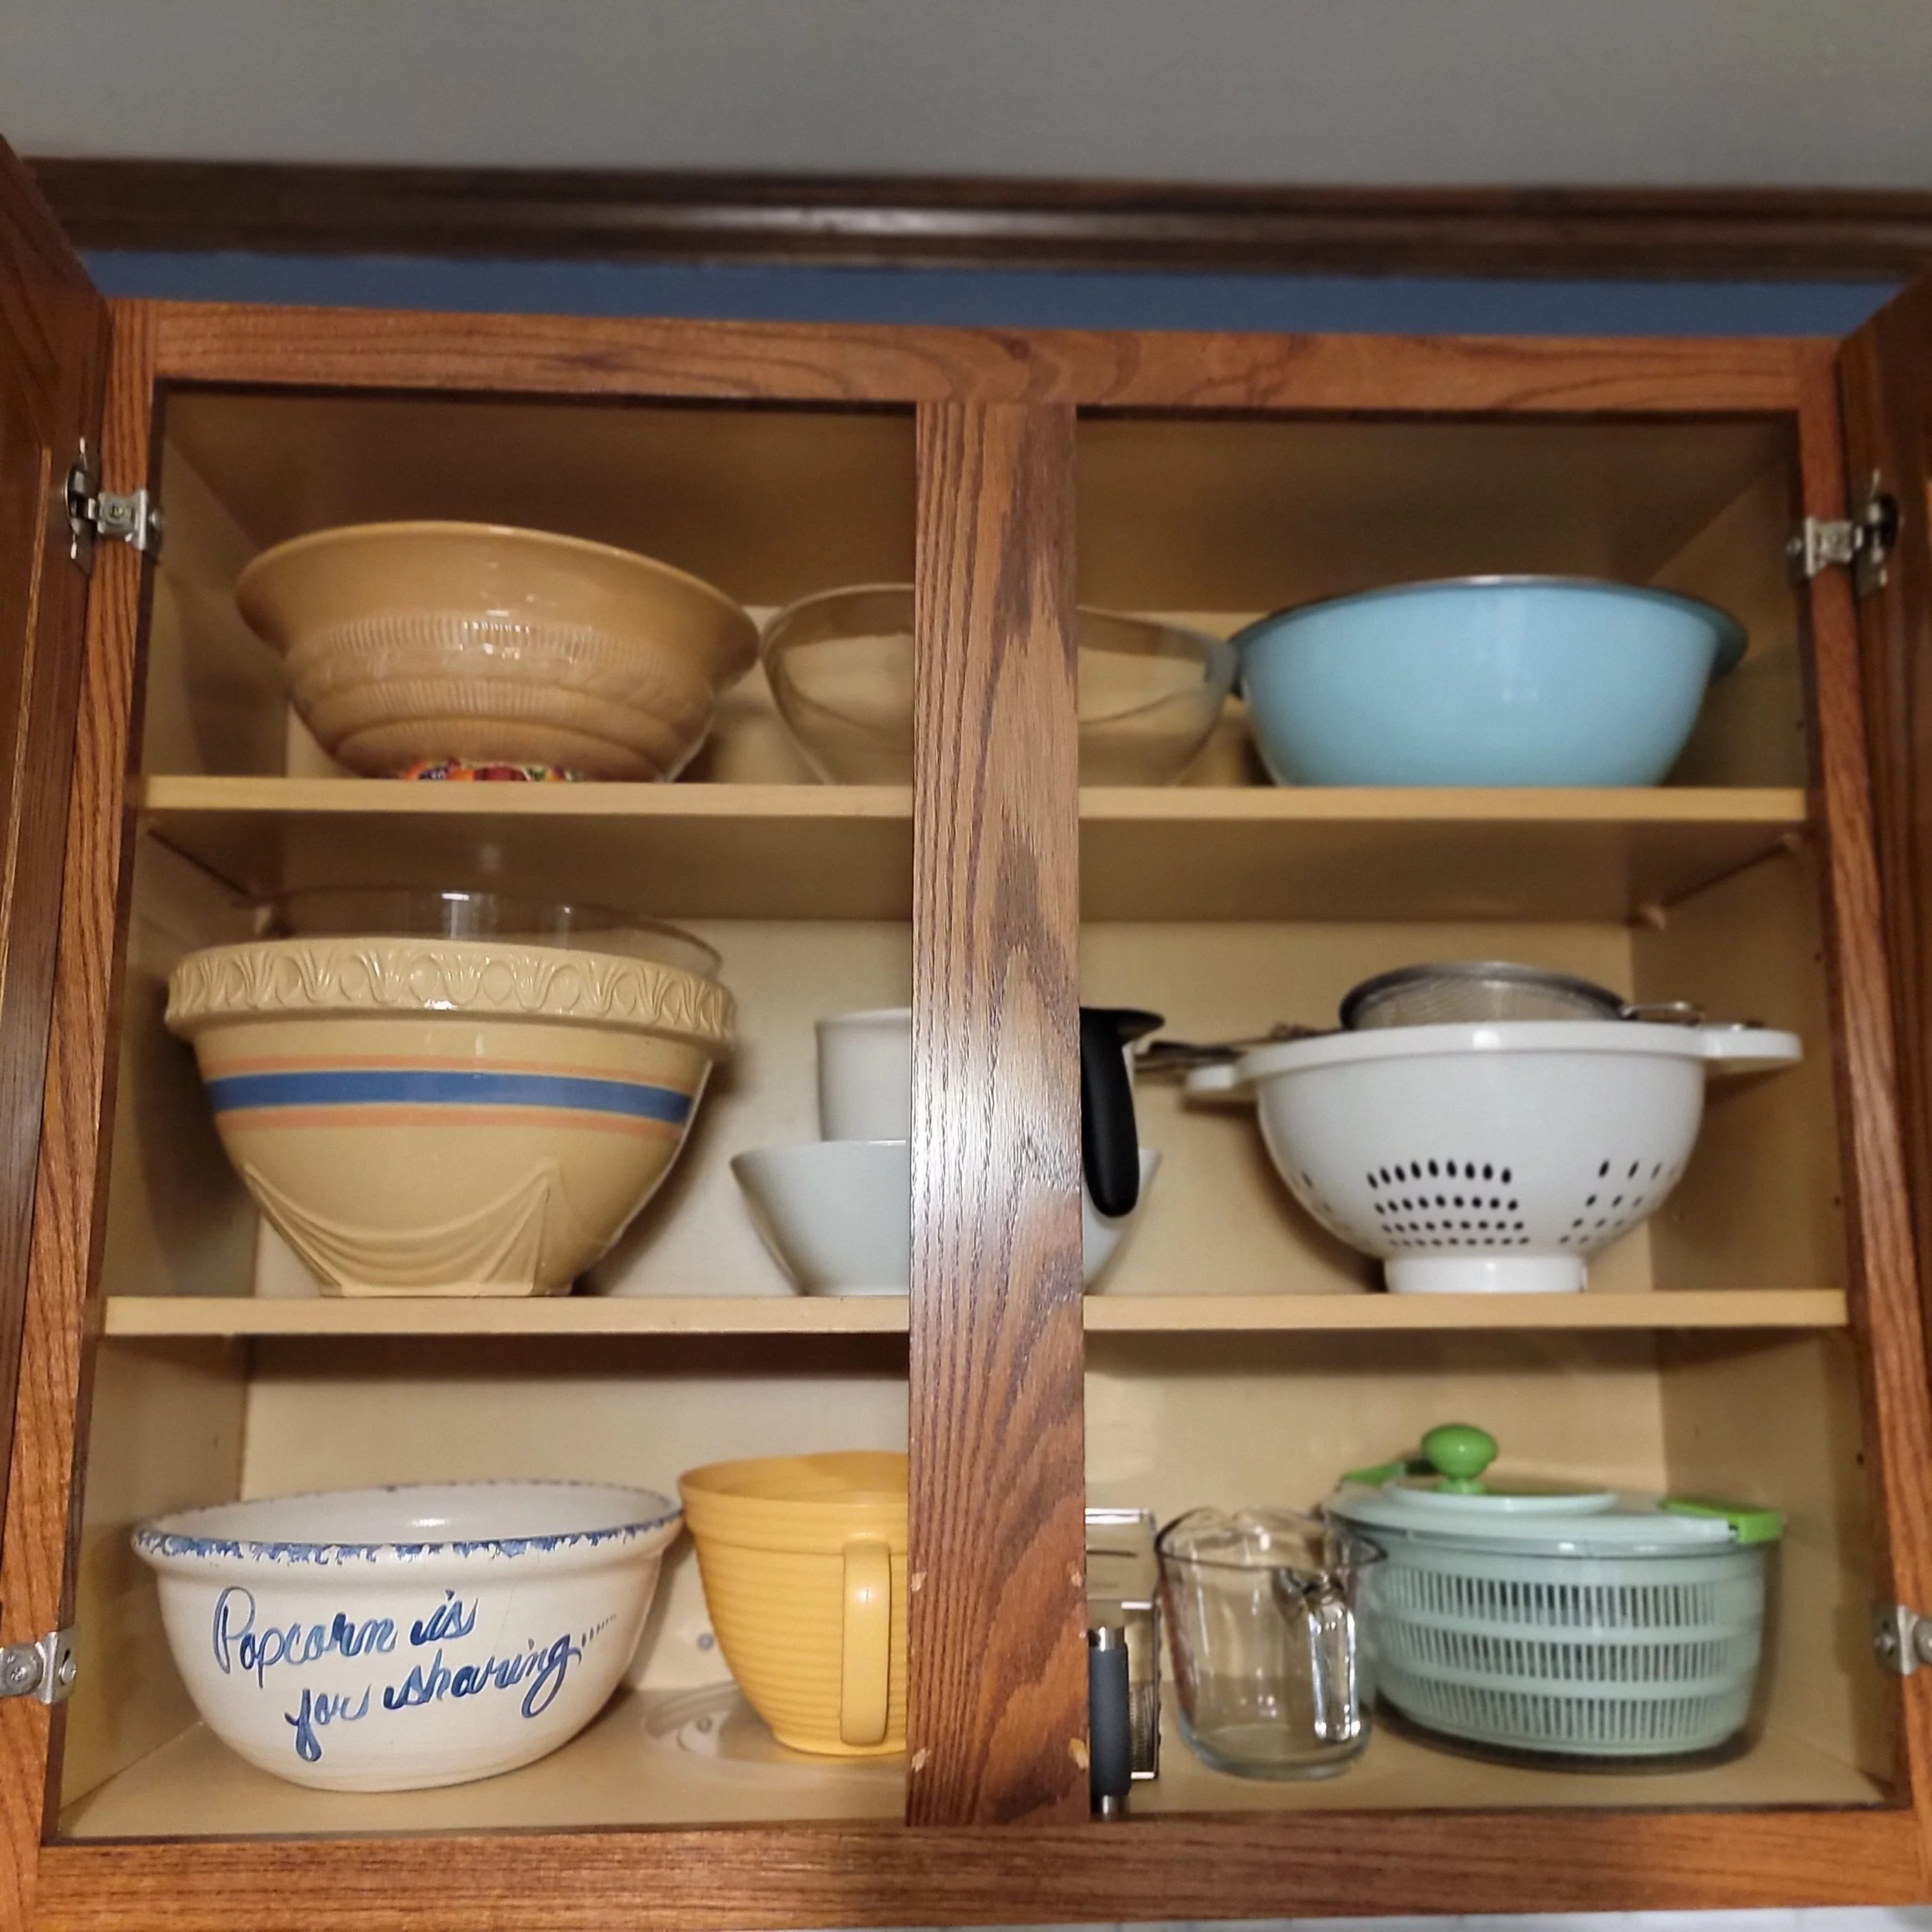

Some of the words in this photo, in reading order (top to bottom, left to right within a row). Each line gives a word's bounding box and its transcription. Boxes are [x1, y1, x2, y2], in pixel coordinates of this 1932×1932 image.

[213, 1586, 399, 1689] Popcorn
[410, 1589, 479, 1646] is
[284, 1686, 370, 1763] for
